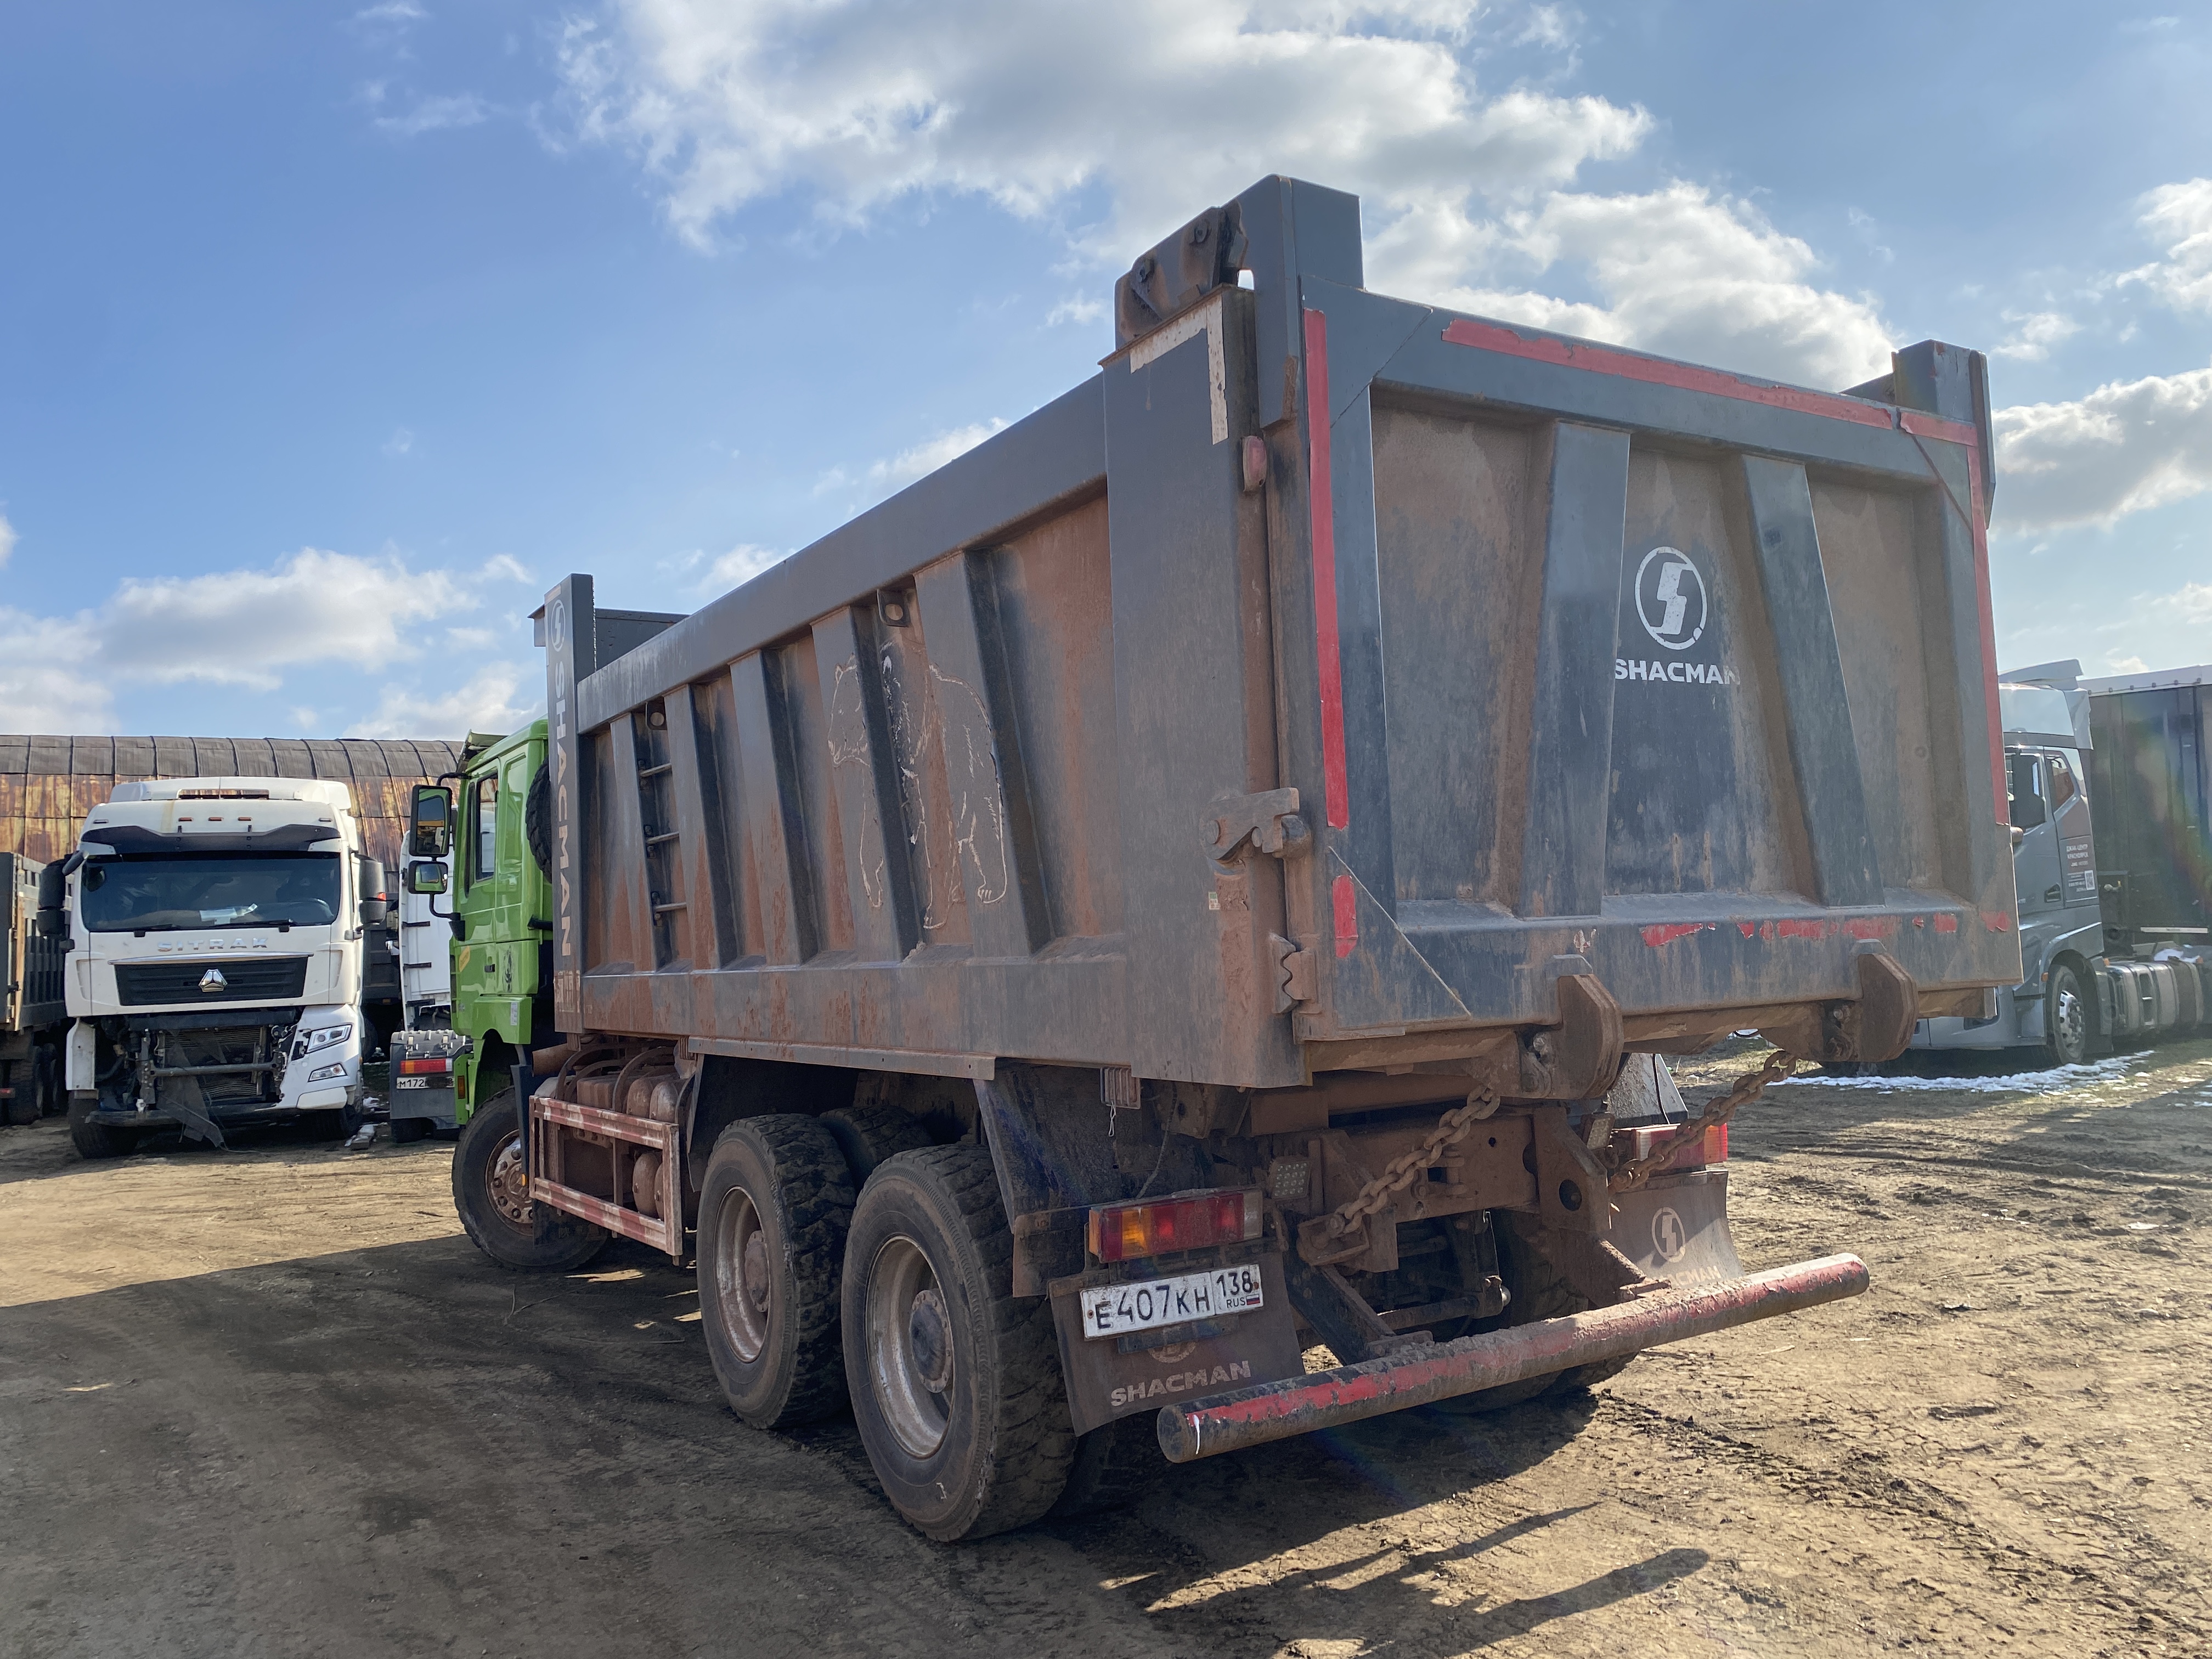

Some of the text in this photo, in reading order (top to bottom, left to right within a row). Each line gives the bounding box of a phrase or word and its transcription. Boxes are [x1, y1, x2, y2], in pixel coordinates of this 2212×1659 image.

[1615, 658, 1741, 685] SHACMAN
[554, 661, 571, 956] SHACMAN
[157, 937, 268, 952] SITRAK
[1216, 1270, 1254, 1297] 138
[1226, 1297, 1246, 1308] RUS
[1110, 1361, 1251, 1406] SHACMAN
